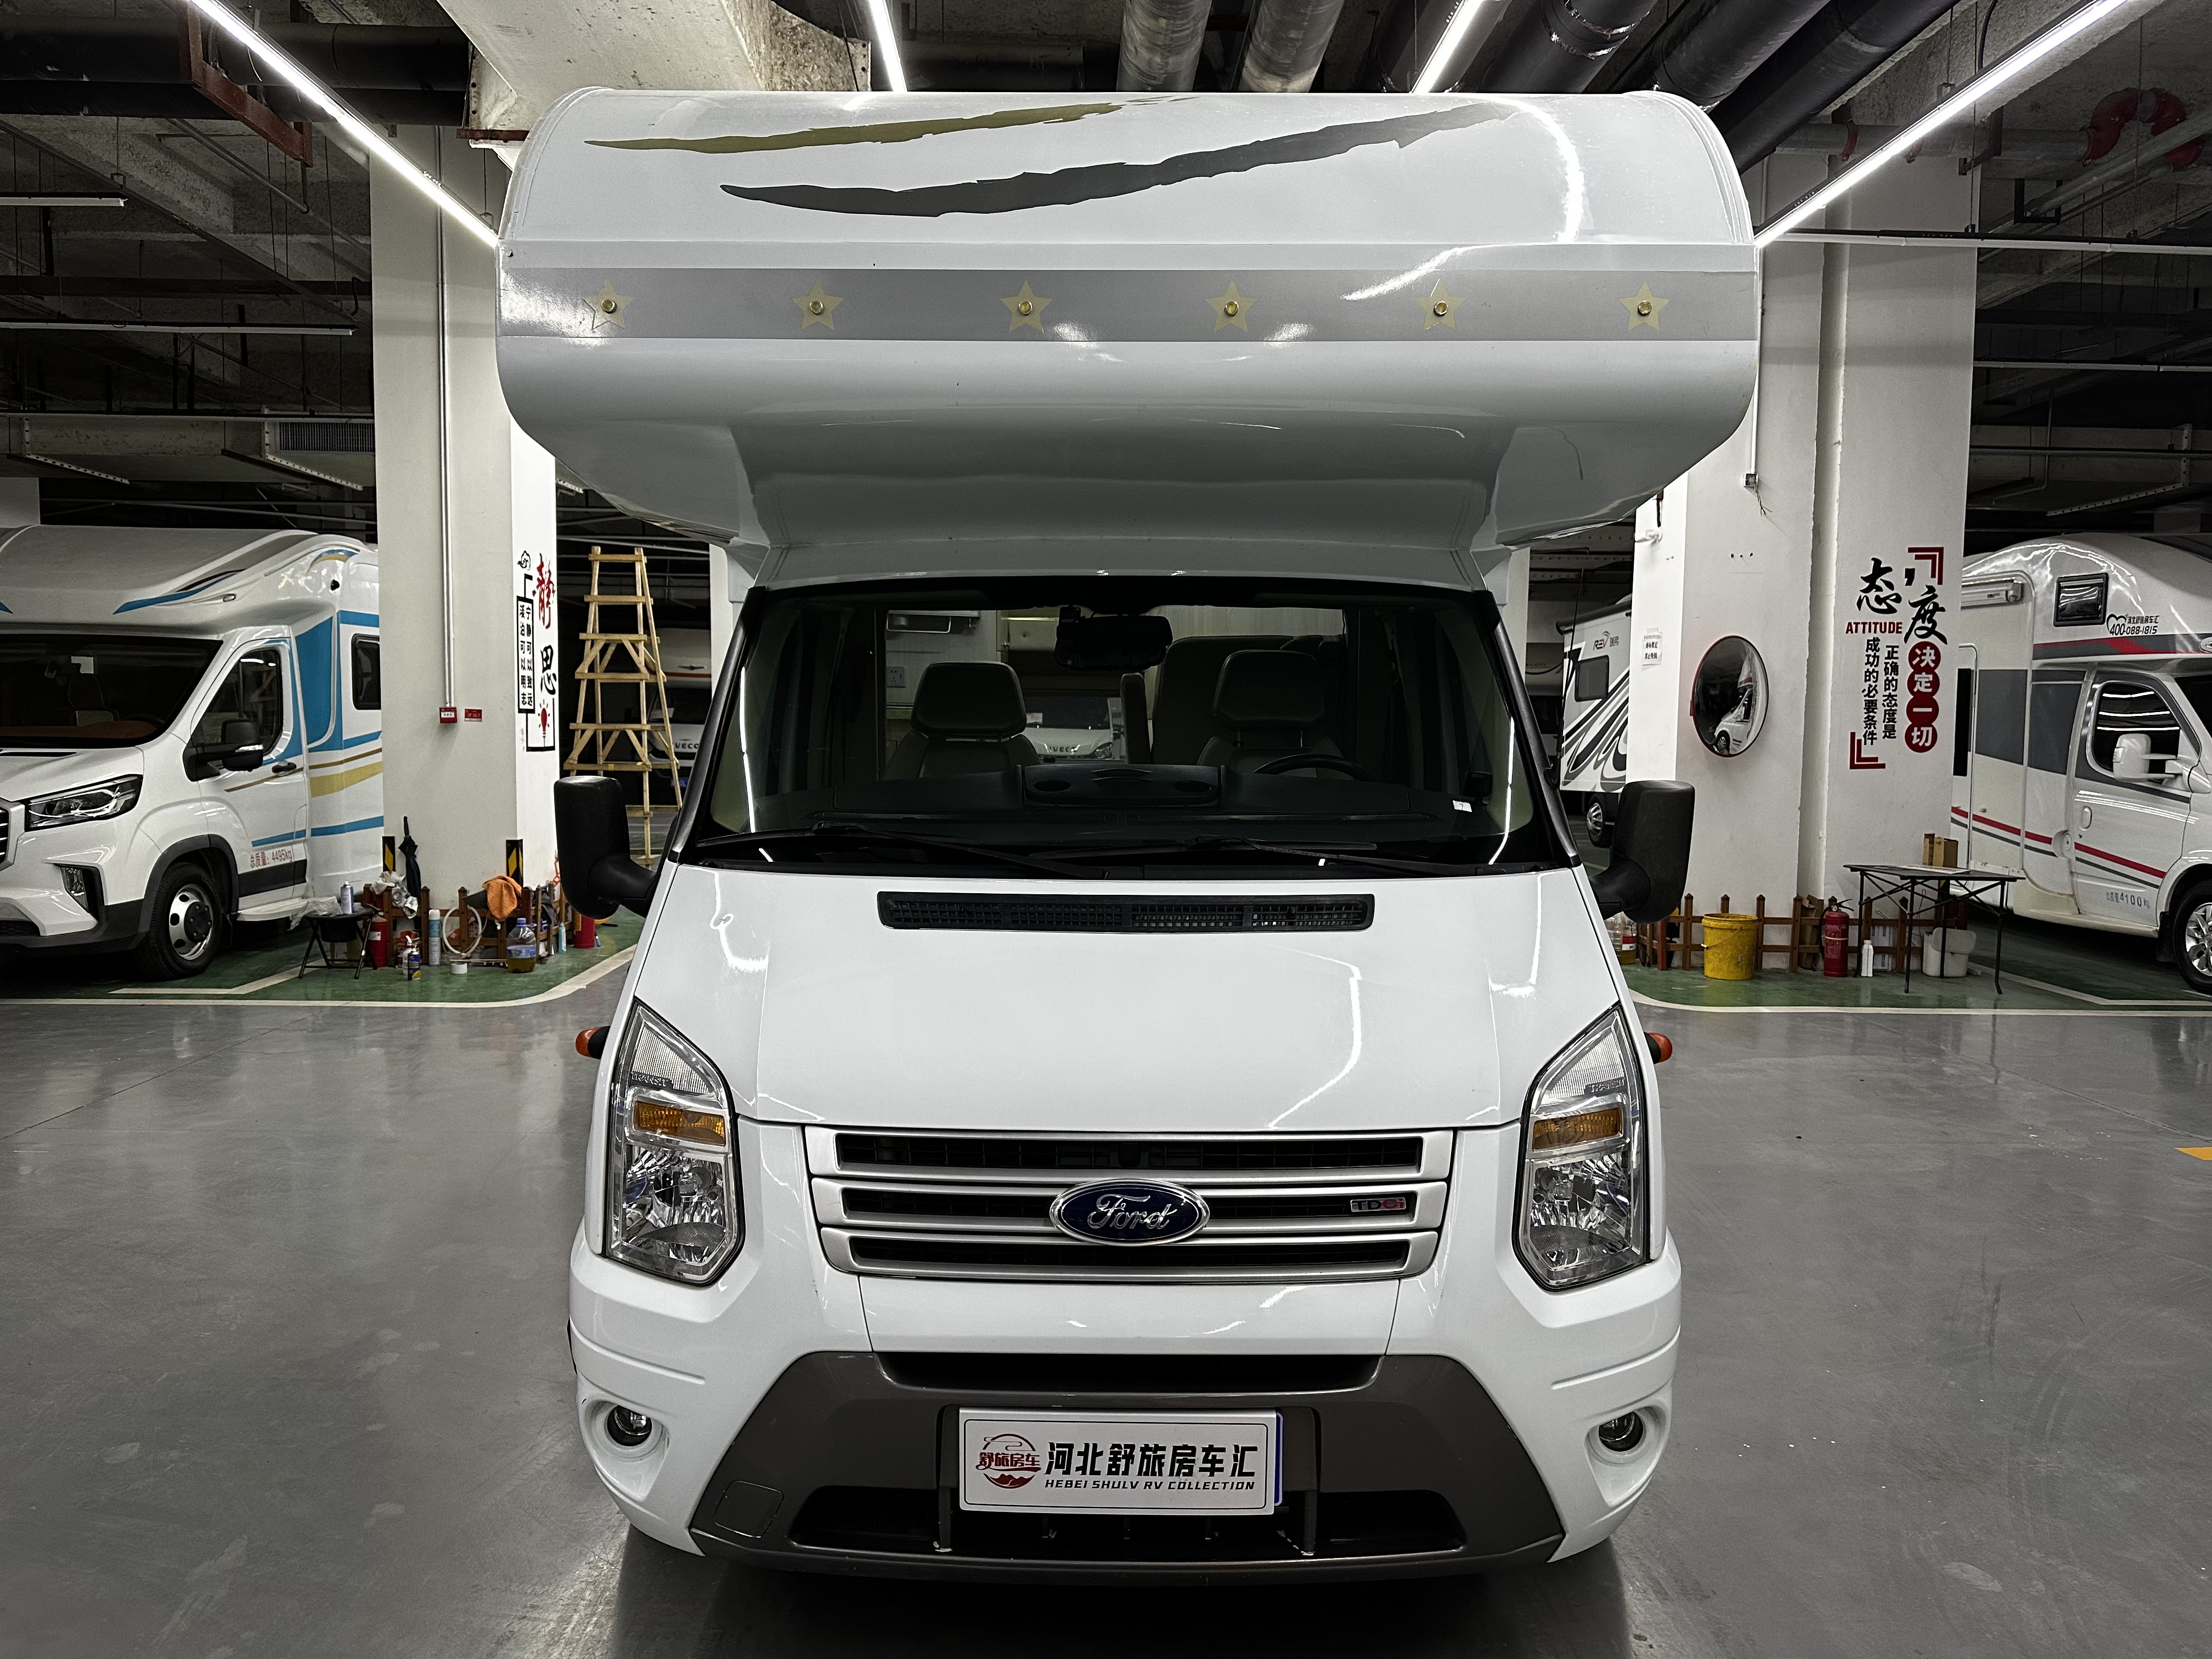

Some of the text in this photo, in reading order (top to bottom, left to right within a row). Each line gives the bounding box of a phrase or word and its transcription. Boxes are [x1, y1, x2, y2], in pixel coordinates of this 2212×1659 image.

[1857, 557, 1948, 645] 态度
[1846, 622, 1903, 634] ATTITUDE
[1861, 637, 1881, 746] 成功的必要条件
[1882, 645, 1900, 740] 正确的态度是
[1911, 646, 1936, 747] 决定一切
[631, 1071, 669, 1087] TRANSIT
[1087, 1194, 1177, 1229] Ford
[1352, 1198, 1404, 1211] TDCi
[978, 1452, 1041, 1469] 舒旅房车
[1043, 1442, 1258, 1477] 河北舒旅房车汇
[1045, 1479, 1255, 1490] HEBEI SHULV RV COLLECTION
